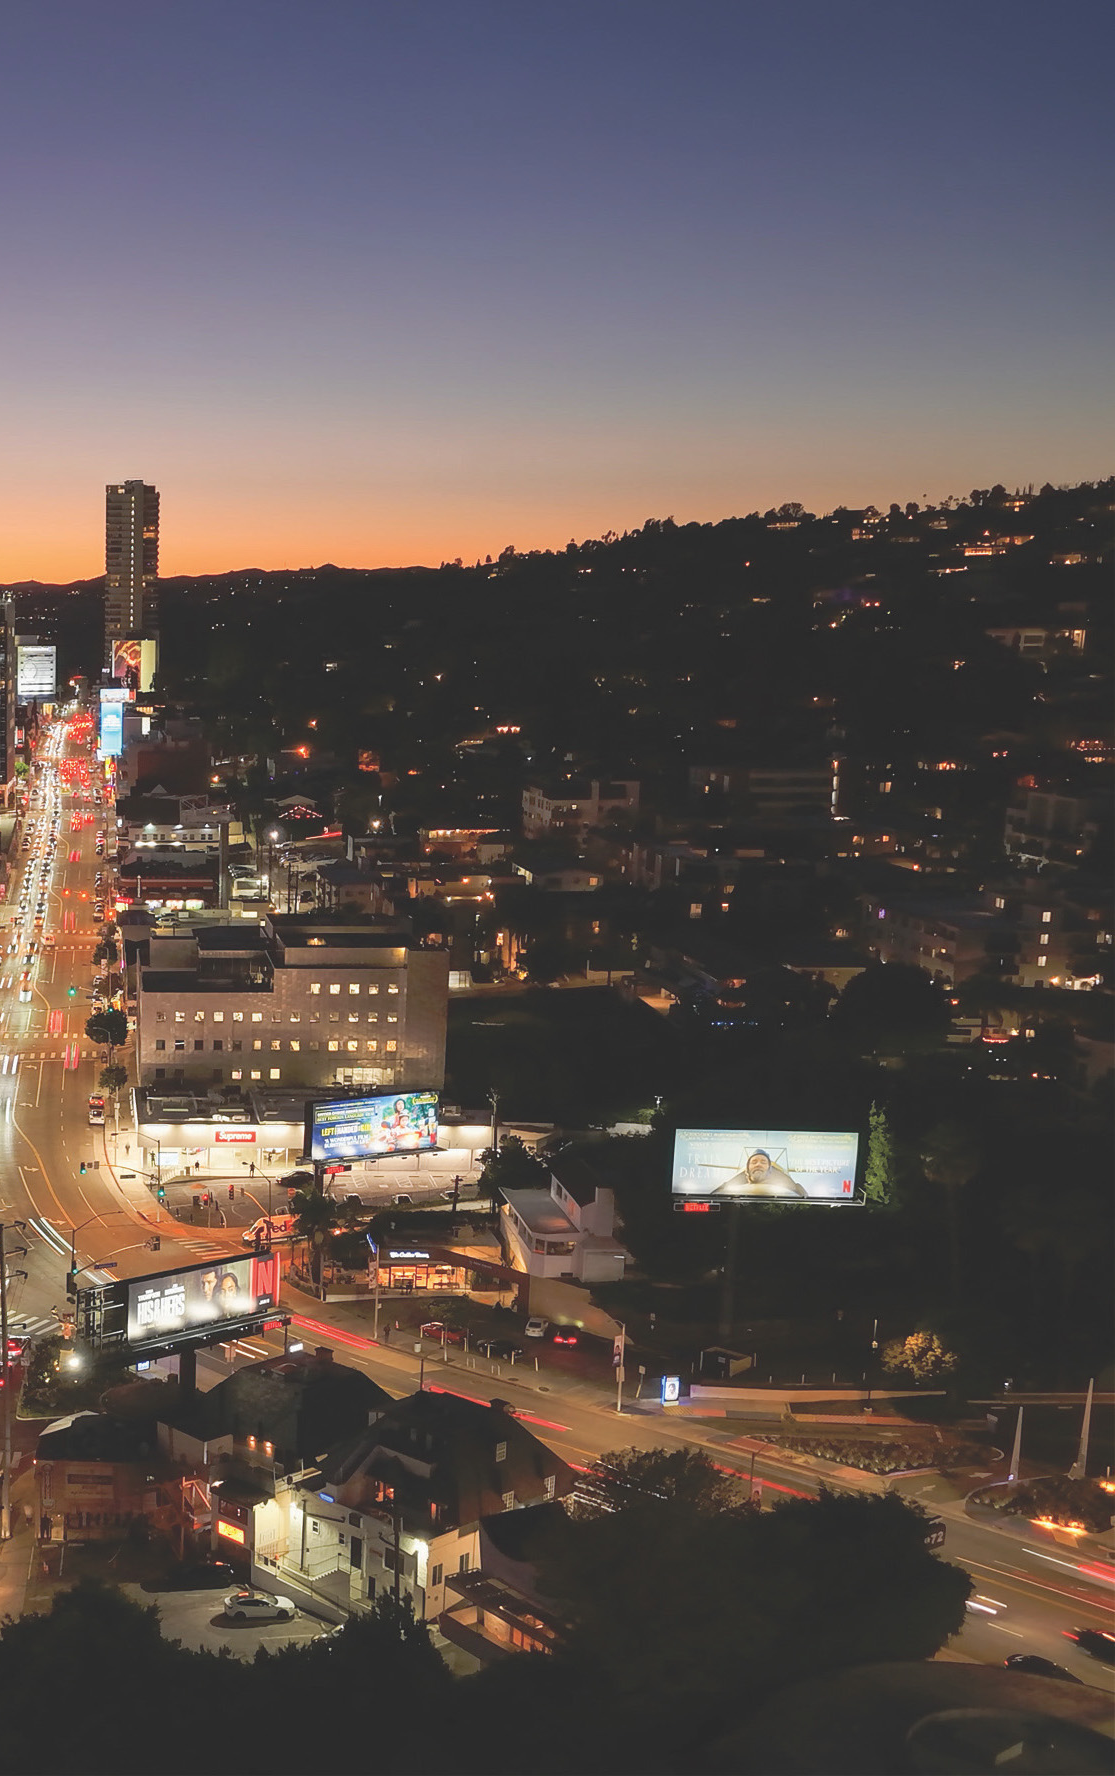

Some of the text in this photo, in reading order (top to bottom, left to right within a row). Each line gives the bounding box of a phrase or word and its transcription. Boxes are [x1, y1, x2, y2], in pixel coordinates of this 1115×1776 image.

[219, 1131, 252, 1142] Supreme
[322, 1128, 334, 1136] LEFT
[842, 1180, 851, 1193] N
[684, 1204, 709, 1212] NETFLIX
[257, 1260, 273, 1296] N
[264, 1322, 283, 1331] NETFLIX
